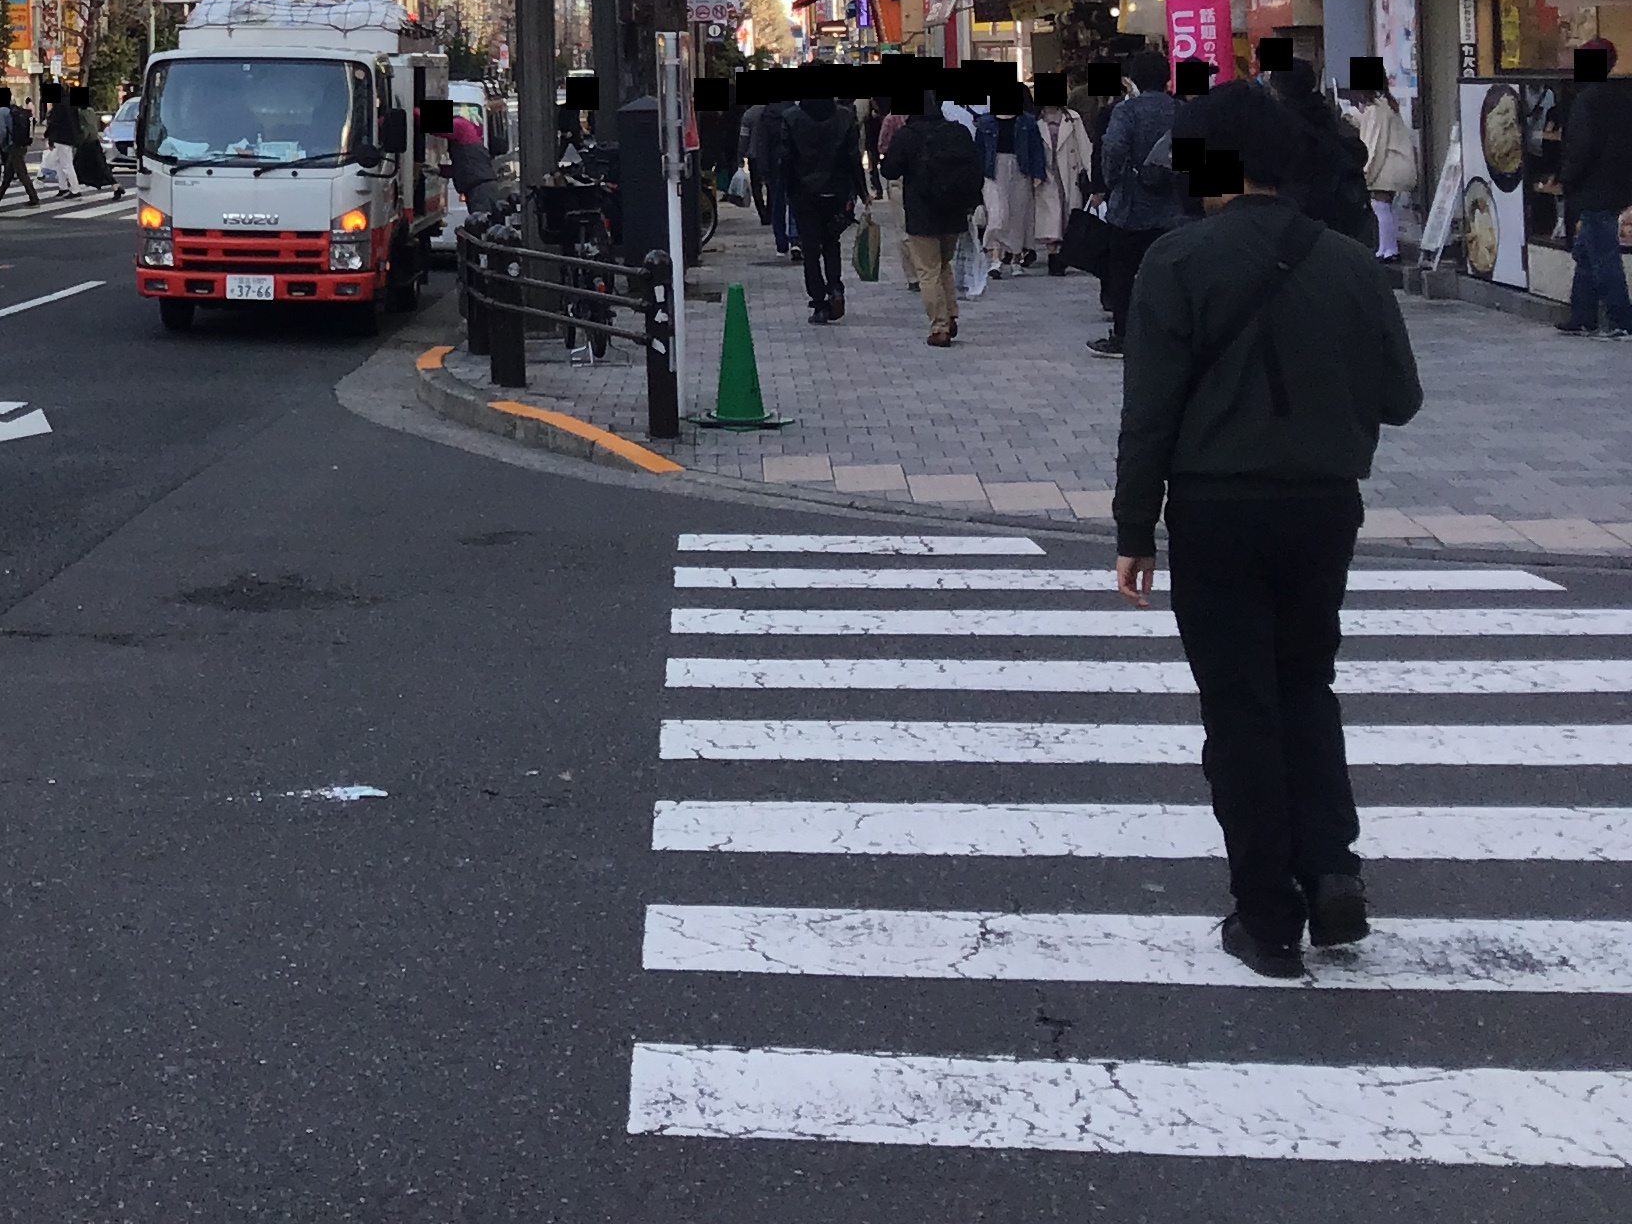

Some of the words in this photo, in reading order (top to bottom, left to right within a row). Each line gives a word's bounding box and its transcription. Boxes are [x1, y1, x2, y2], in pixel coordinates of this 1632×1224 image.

[1171, 9, 1197, 59] UQ
[1199, 7, 1219, 89] 話題のス
[221, 212, 279, 225] ISUZU
[237, 284, 272, 298] 37-66
